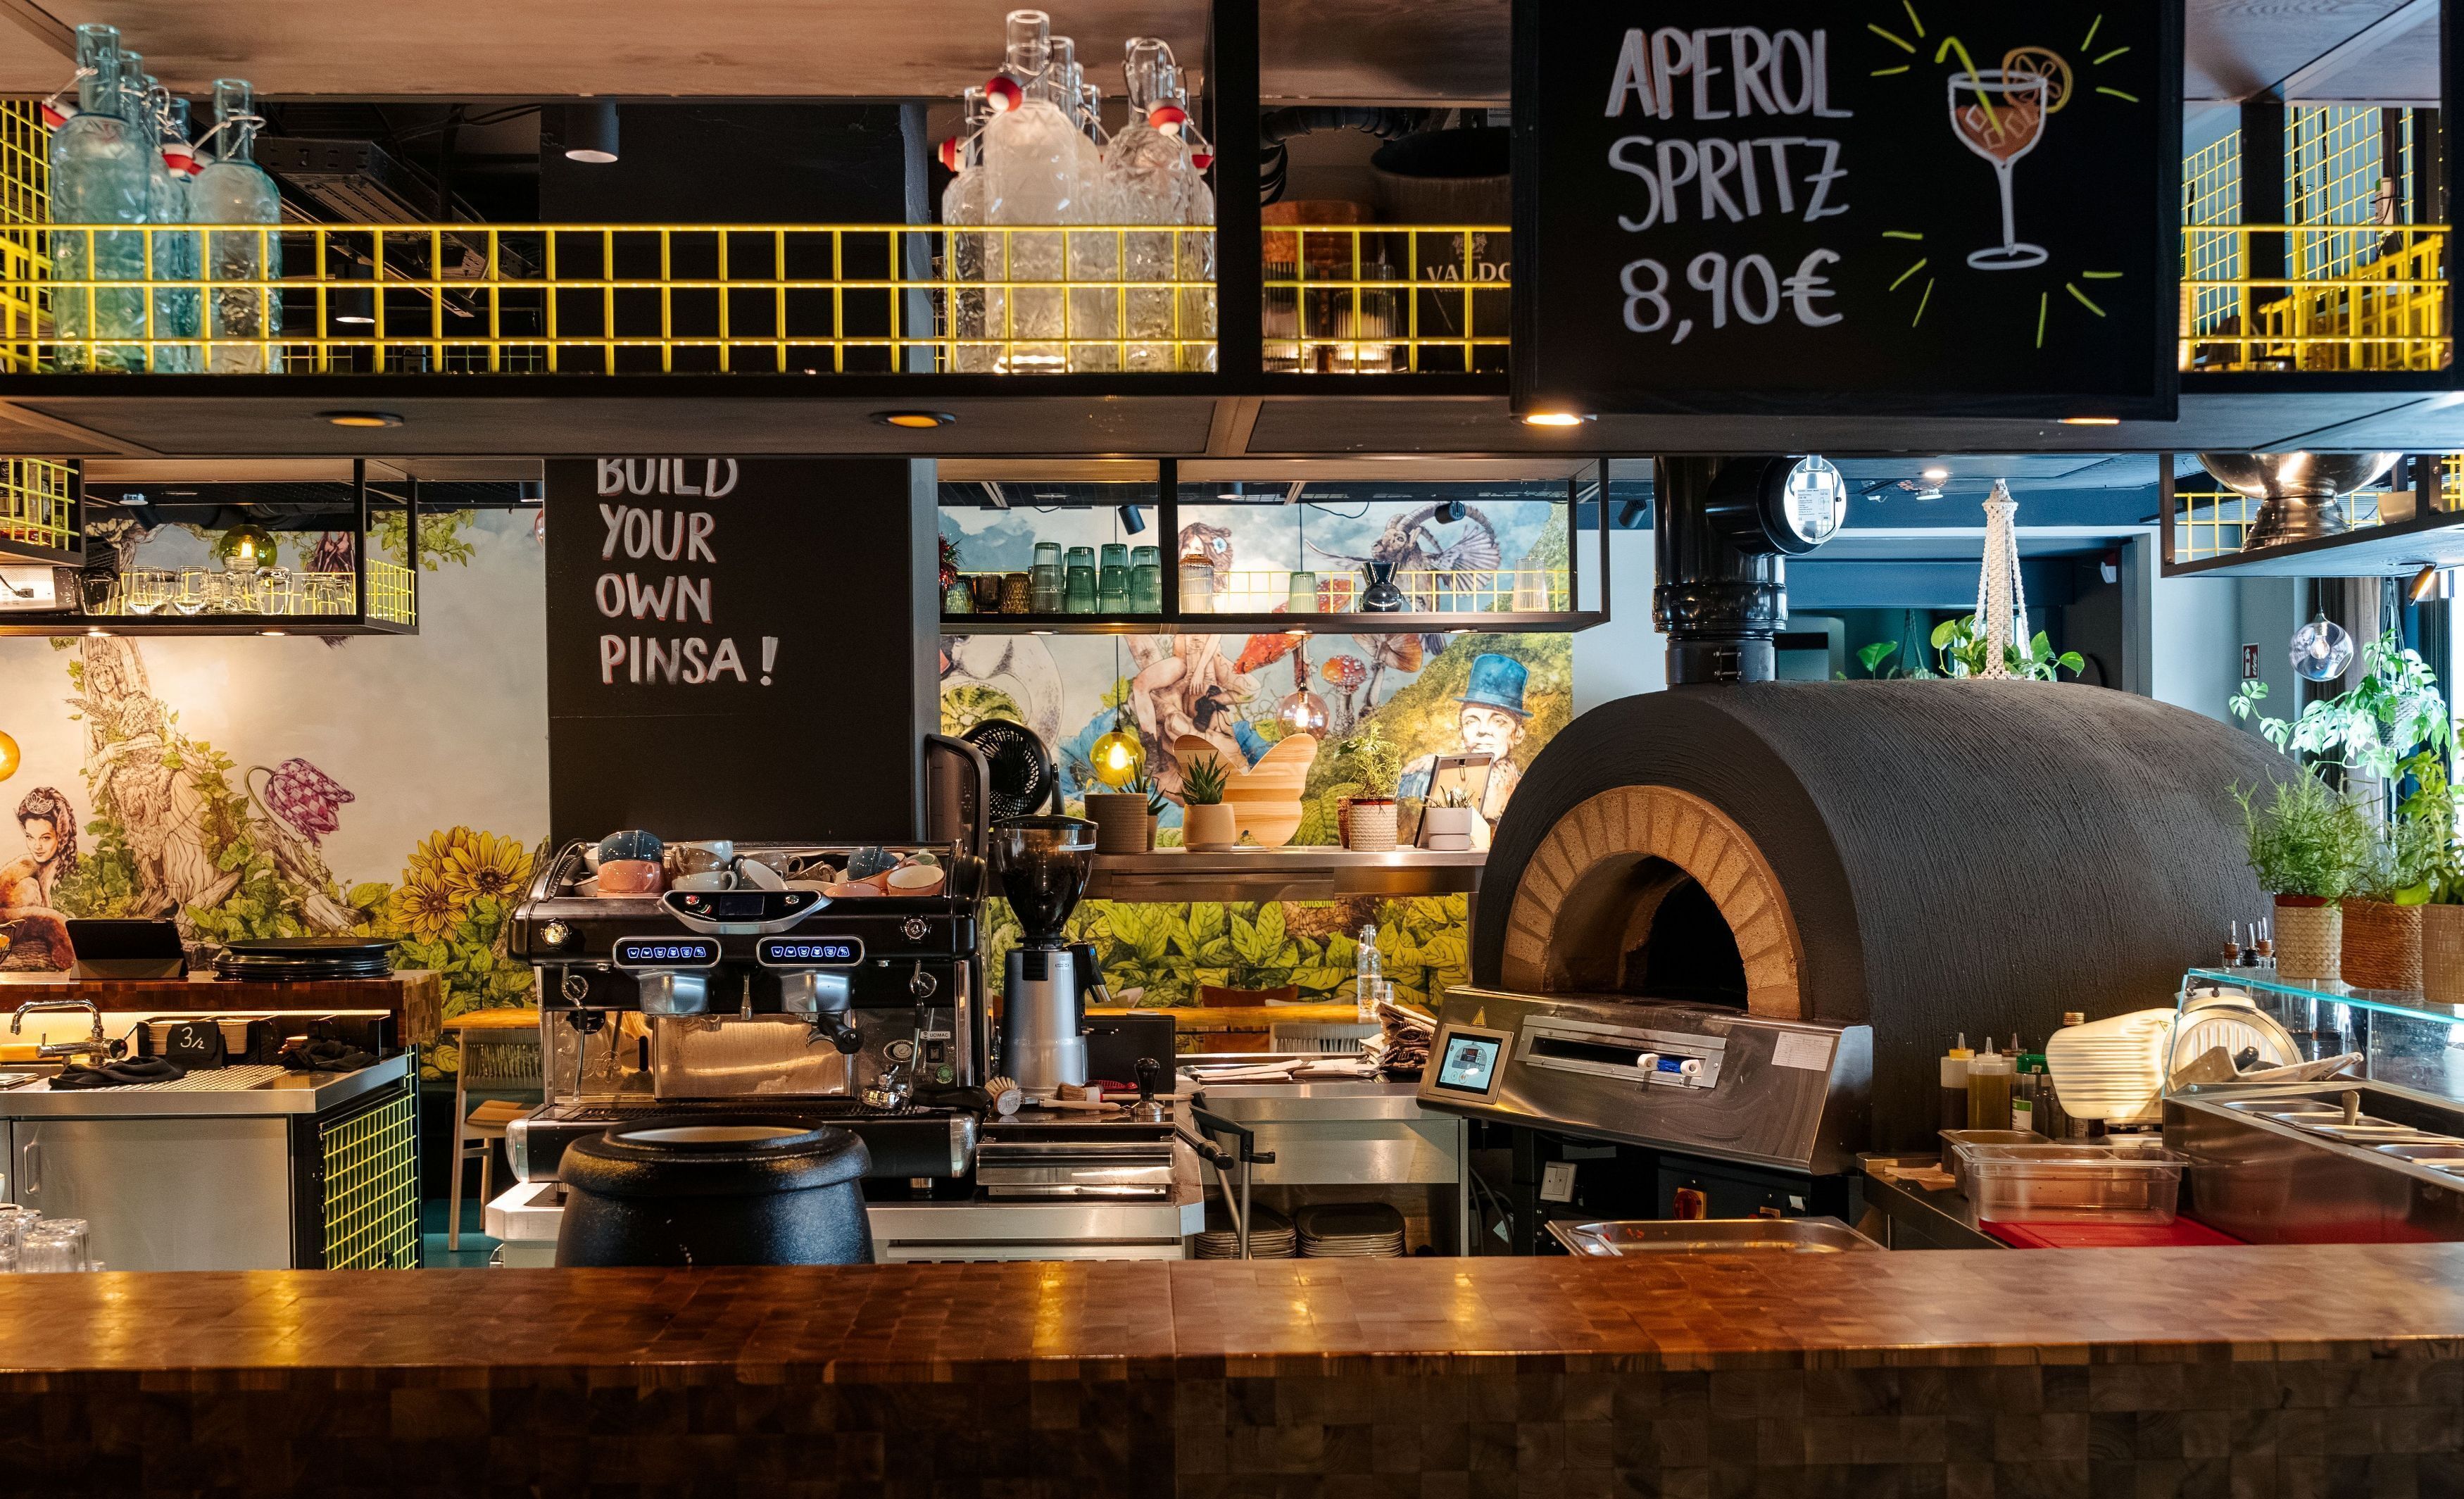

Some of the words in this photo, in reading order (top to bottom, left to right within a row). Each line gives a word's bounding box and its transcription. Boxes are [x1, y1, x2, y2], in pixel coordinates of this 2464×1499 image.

[1604, 26, 1854, 120] APEROL
[1608, 135, 1849, 232] SPRITZ
[1620, 248, 1844, 344] 8,90€
[598, 458, 738, 499] BUILD
[599, 503, 717, 563] YOUR
[596, 572, 713, 624] OWN
